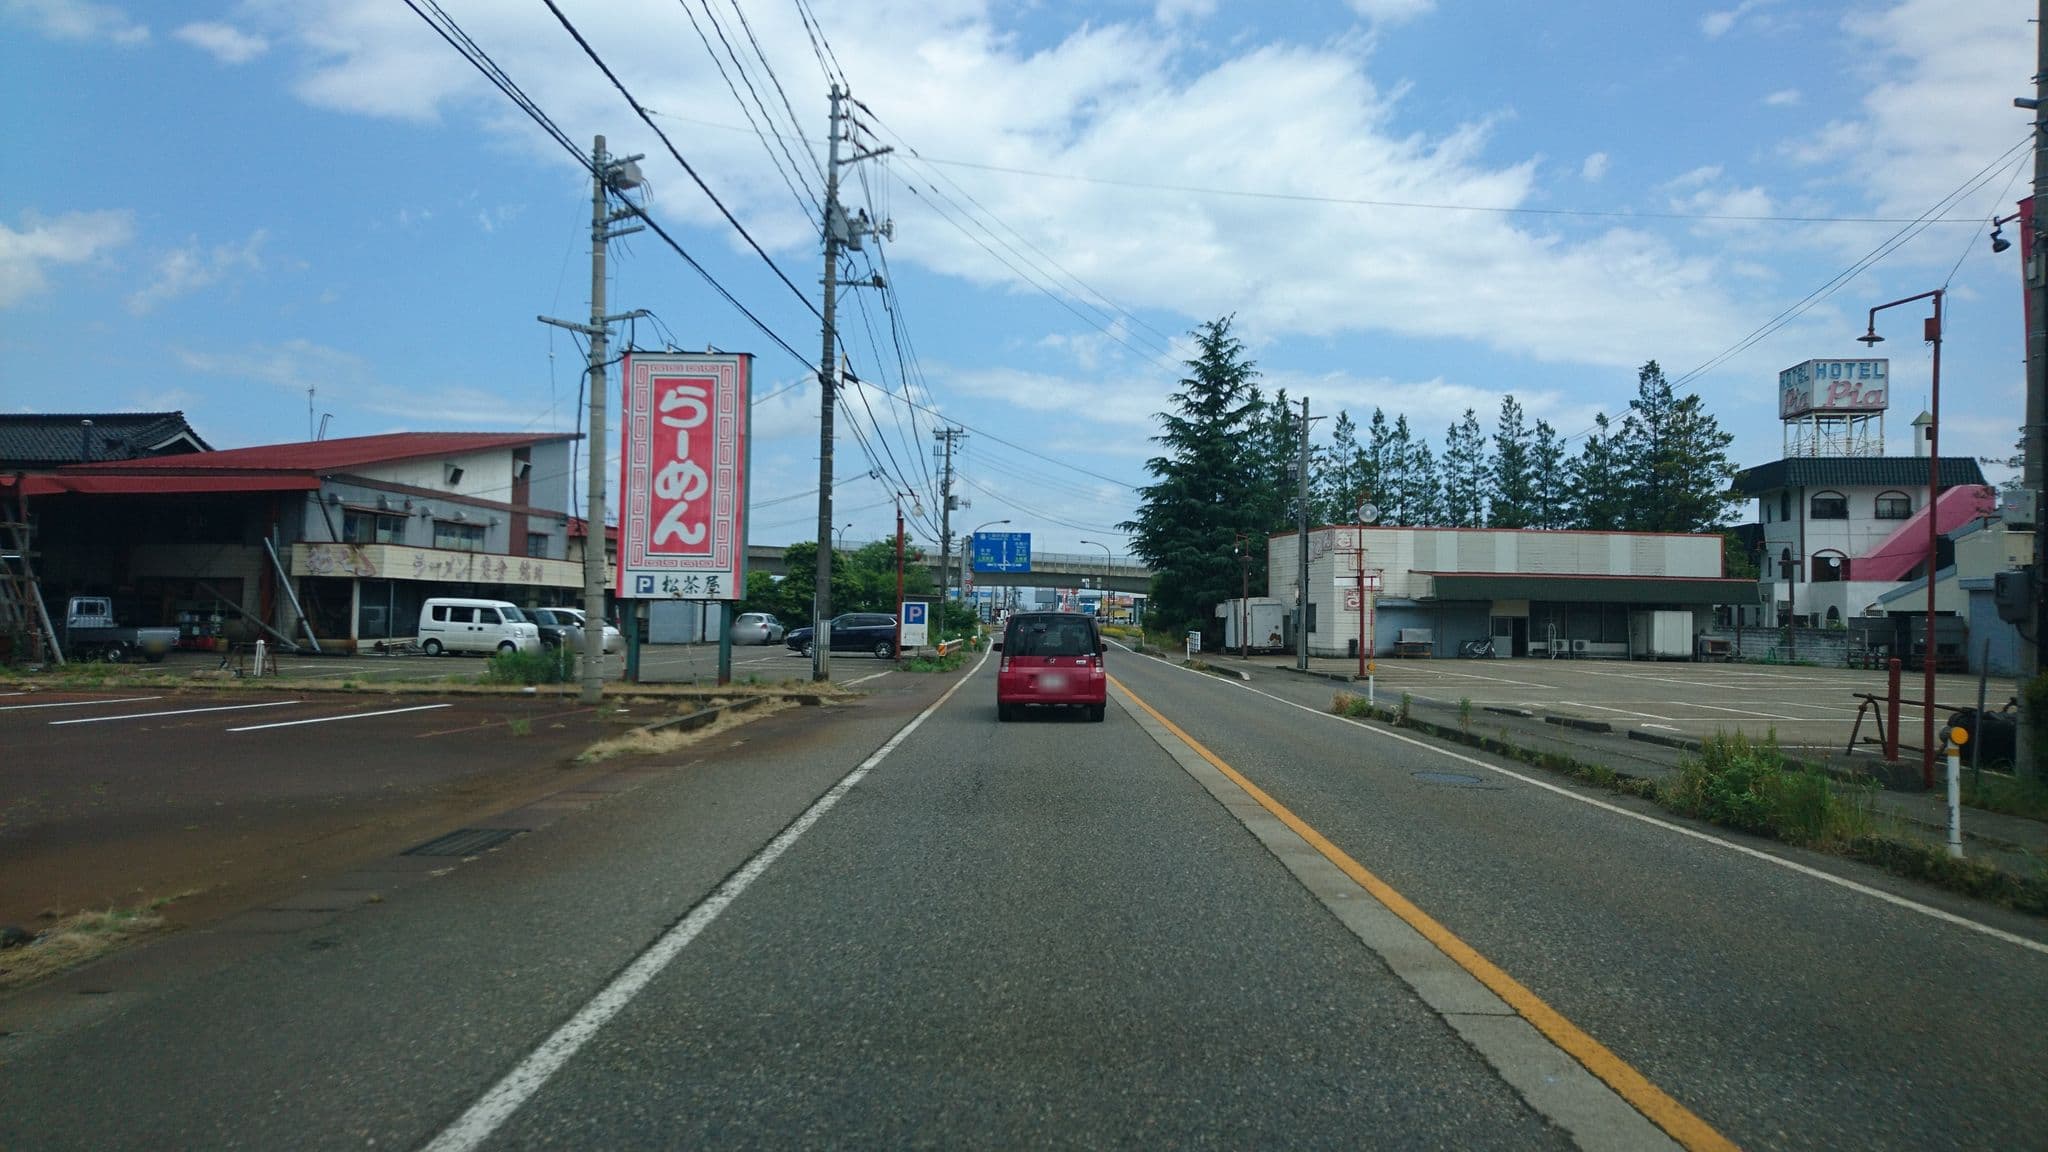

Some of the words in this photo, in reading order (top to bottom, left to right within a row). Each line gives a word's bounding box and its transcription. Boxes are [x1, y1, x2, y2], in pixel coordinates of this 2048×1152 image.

[1816, 362, 1885, 380] HOTEL
[1823, 380, 1885, 408] Pia
[653, 385, 709, 546] らーめん
[638, 577, 651, 593] P
[662, 575, 722, 595] 松茶屋
[909, 606, 923, 623] P
